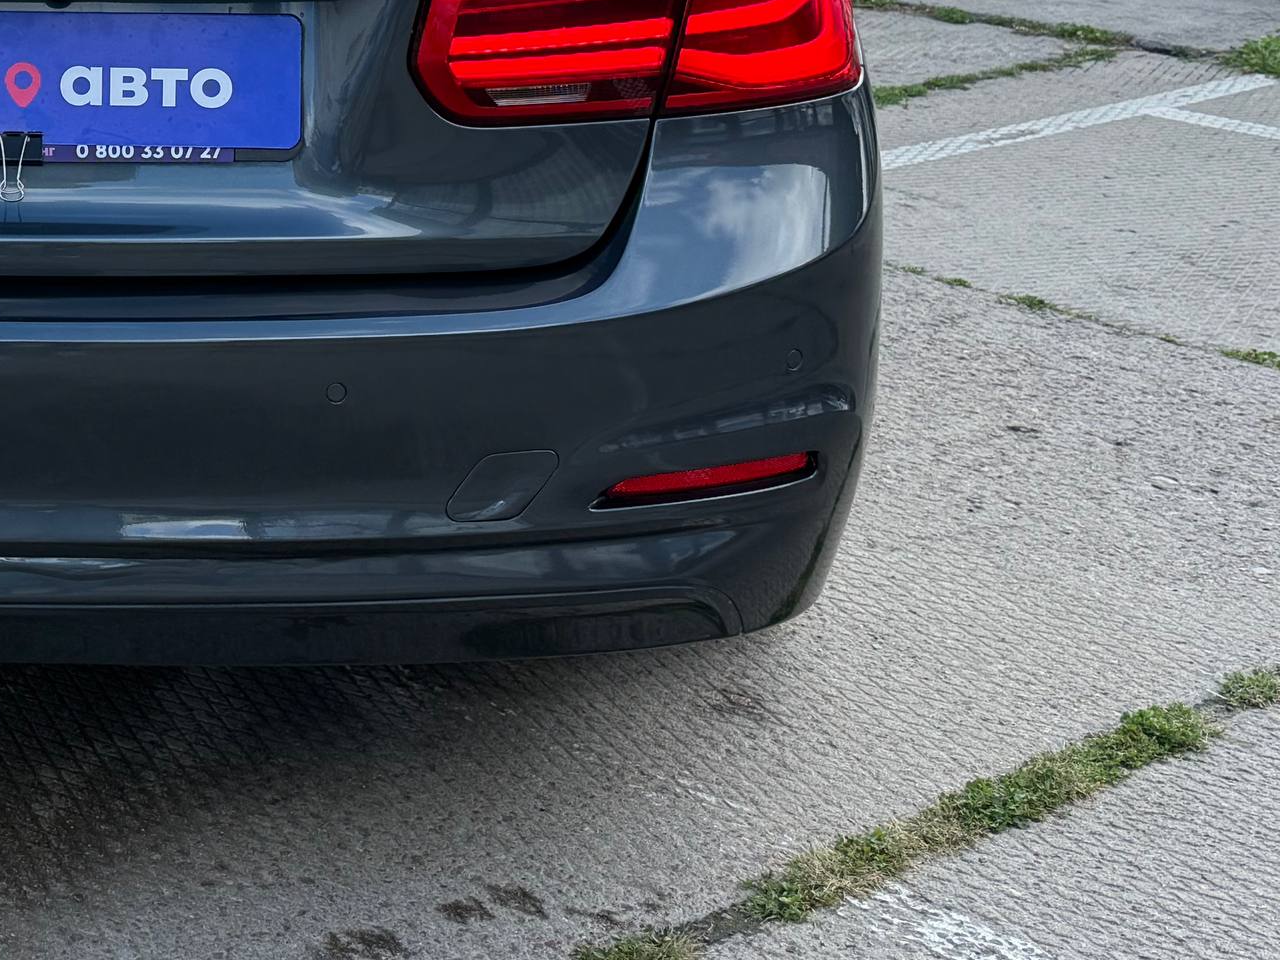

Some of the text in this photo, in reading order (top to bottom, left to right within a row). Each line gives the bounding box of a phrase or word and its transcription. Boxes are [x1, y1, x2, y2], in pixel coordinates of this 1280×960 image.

[60, 65, 233, 109] авто
[75, 144, 89, 159] 0
[95, 145, 135, 159] 800
[140, 147, 165, 159] 33
